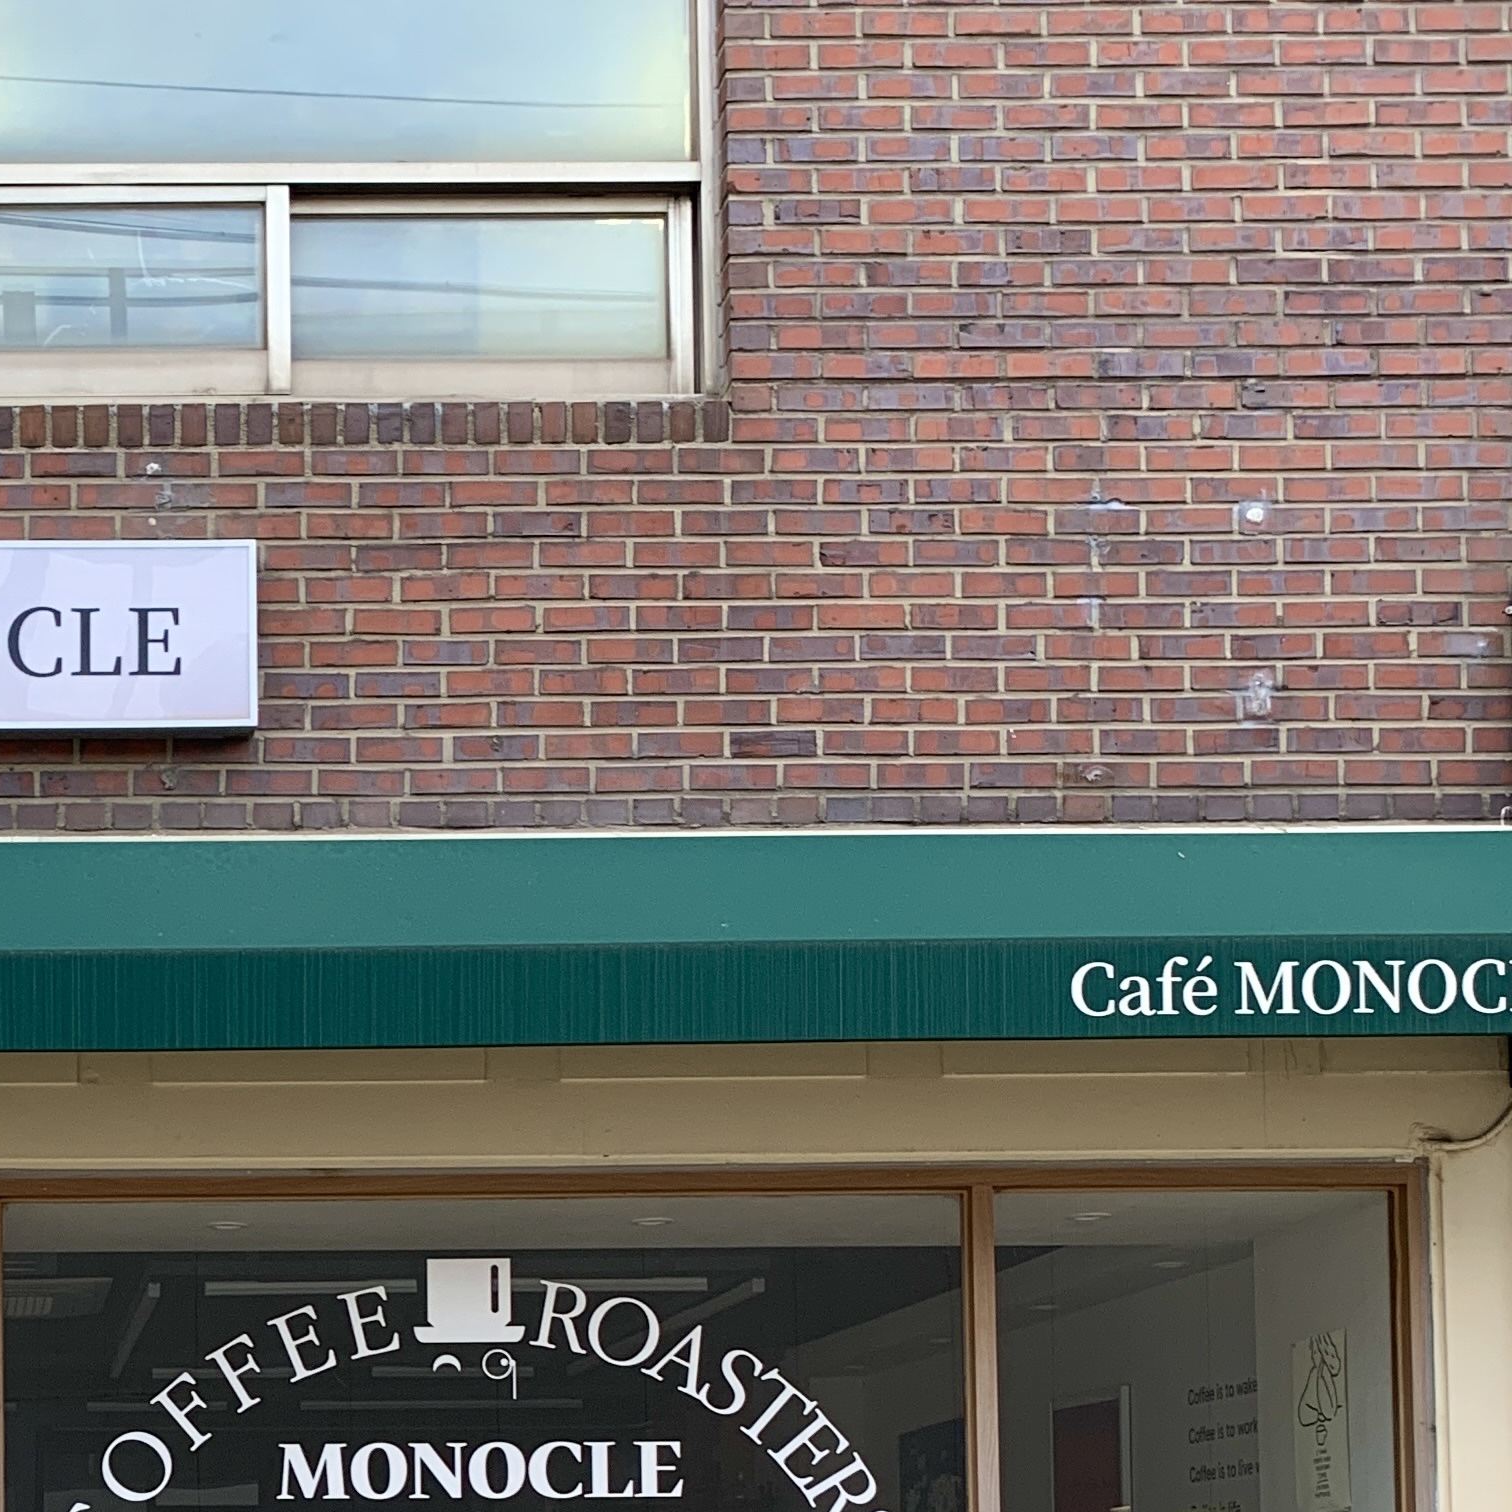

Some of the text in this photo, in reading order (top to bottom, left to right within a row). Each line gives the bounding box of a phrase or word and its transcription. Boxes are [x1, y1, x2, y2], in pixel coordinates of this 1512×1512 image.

[1070, 955, 1512, 1017] Café MONOC
[1225, 1383, 1235, 1399] to
[1226, 1423, 1236, 1438] to
[276, 1441, 684, 1500] MONOCLE
[1226, 1463, 1237, 1478] to
